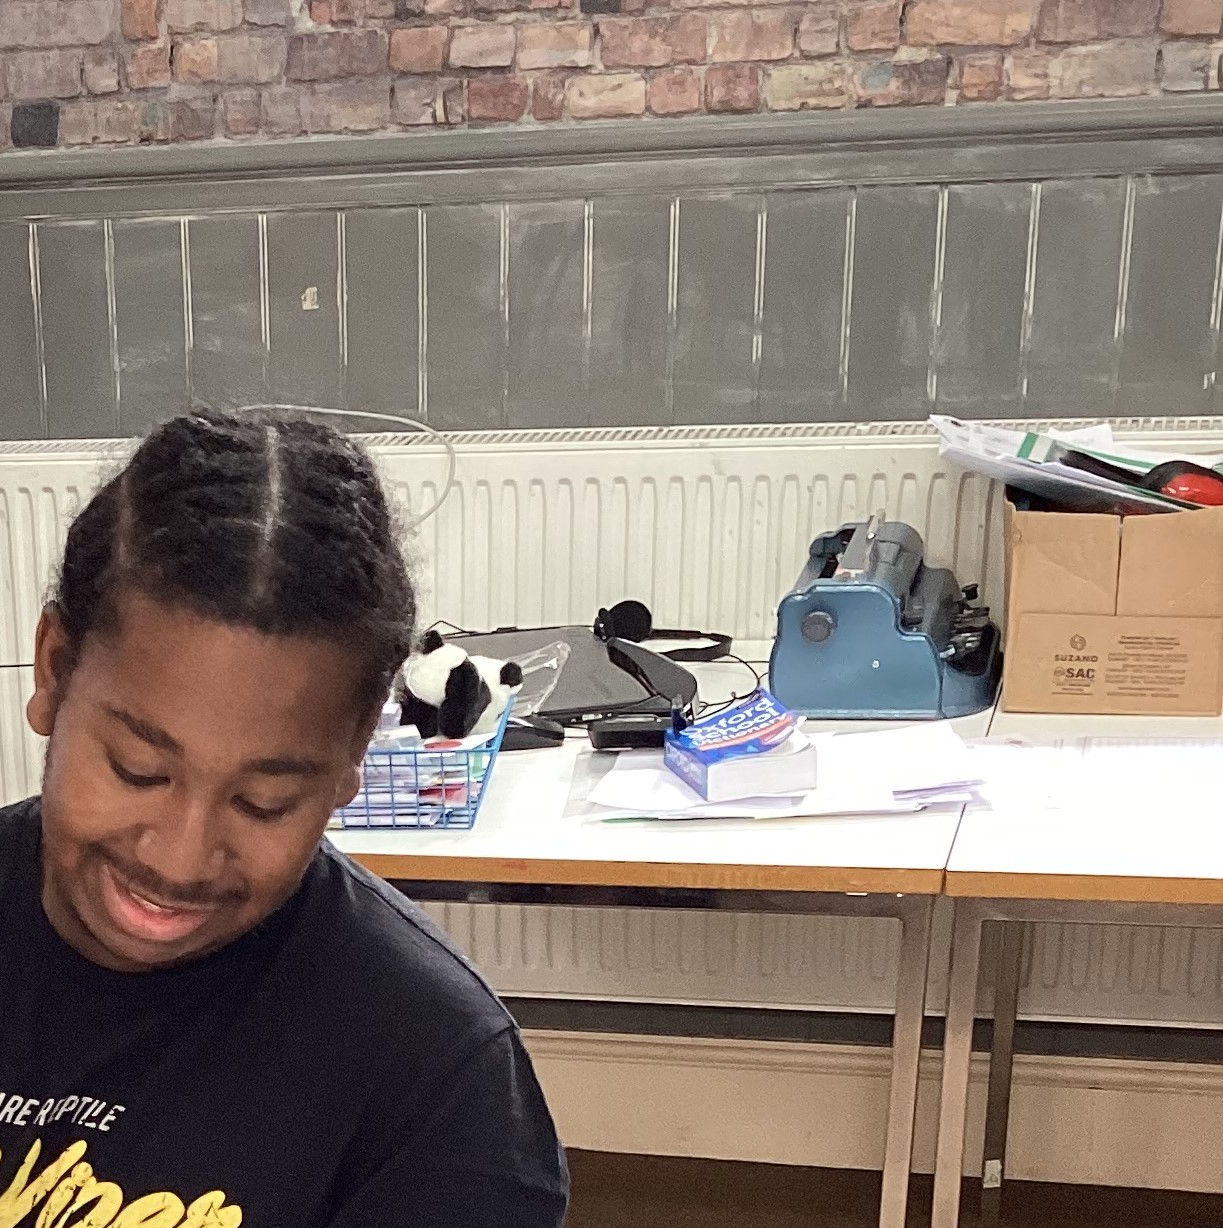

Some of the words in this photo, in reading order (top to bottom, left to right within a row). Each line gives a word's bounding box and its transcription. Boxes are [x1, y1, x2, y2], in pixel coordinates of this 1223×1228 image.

[1053, 654, 1099, 663] SUZANO
[1065, 667, 1096, 679] SAC
[679, 697, 775, 737] Oxford
[688, 707, 781, 742] School
[691, 712, 788, 746] Dictionary
